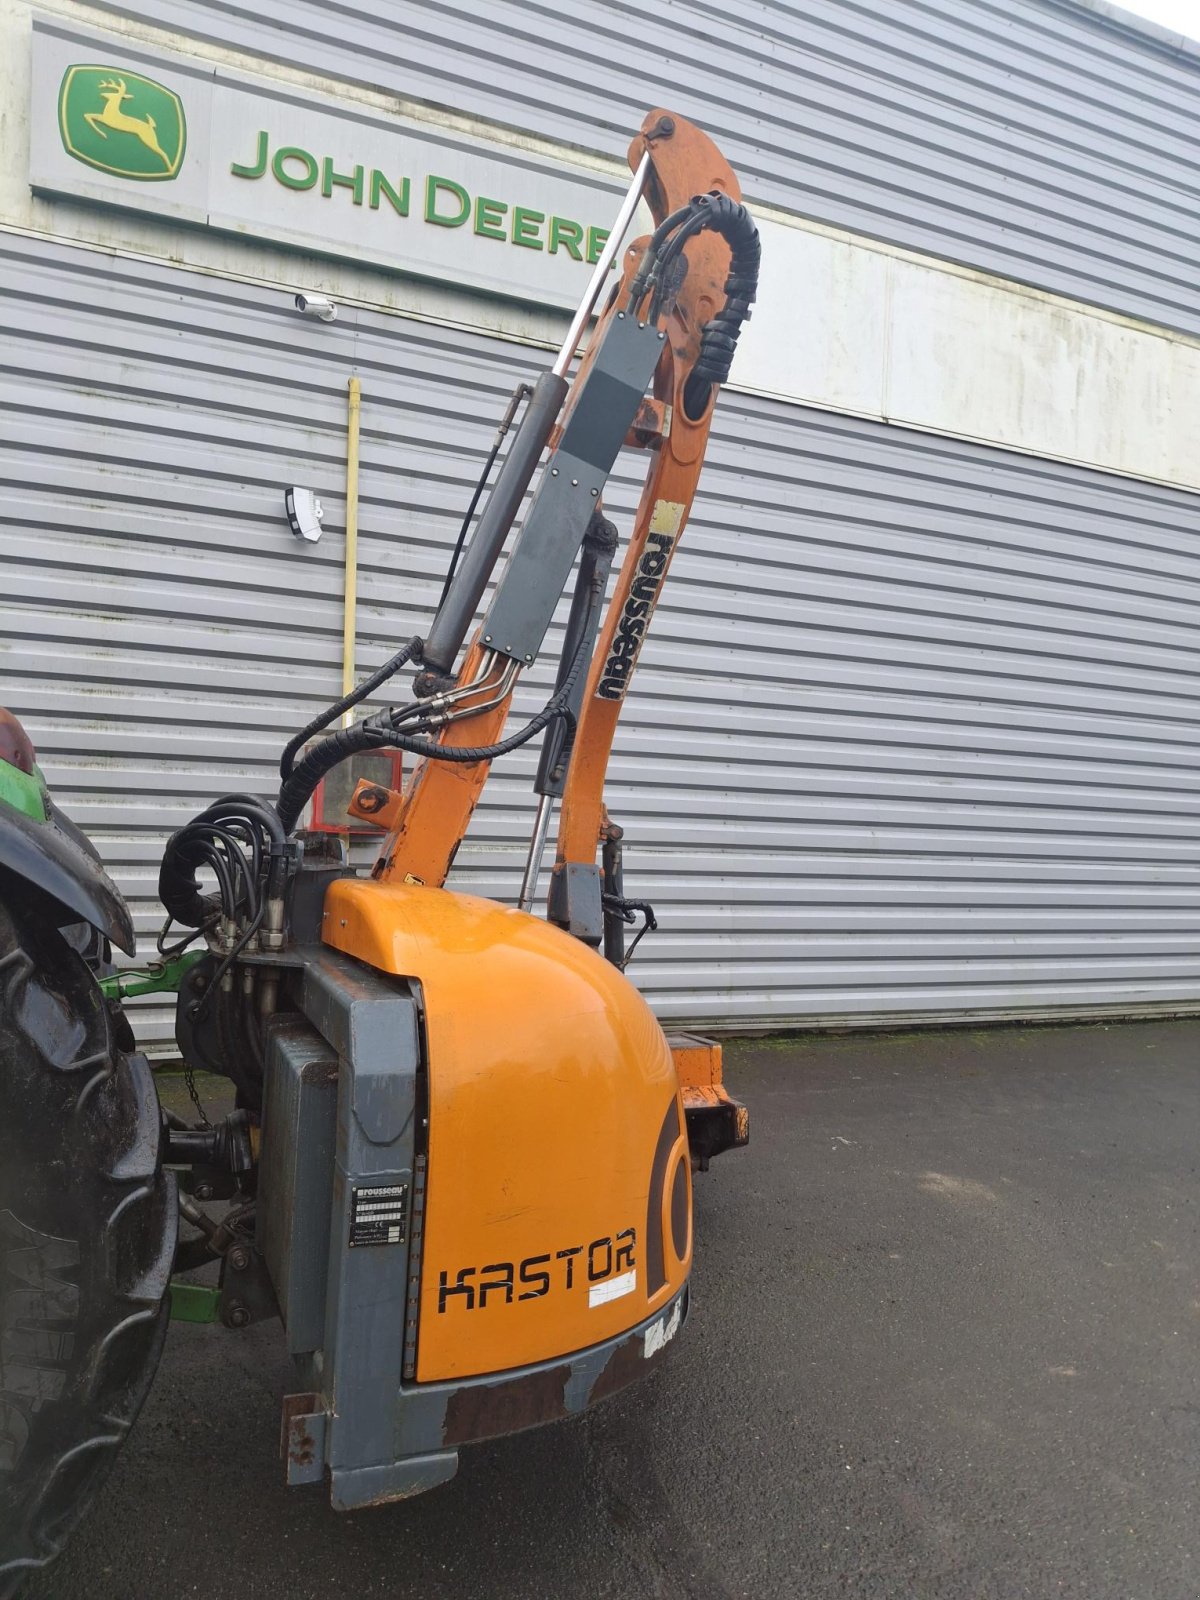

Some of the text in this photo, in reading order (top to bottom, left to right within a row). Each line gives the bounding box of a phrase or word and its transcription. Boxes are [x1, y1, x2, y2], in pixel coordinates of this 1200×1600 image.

[231, 130, 617, 270] JOHN DEERE
[599, 533, 675, 700] rousseau
[364, 1187, 403, 1196] rousseau
[438, 1227, 637, 1314] KASTOR
